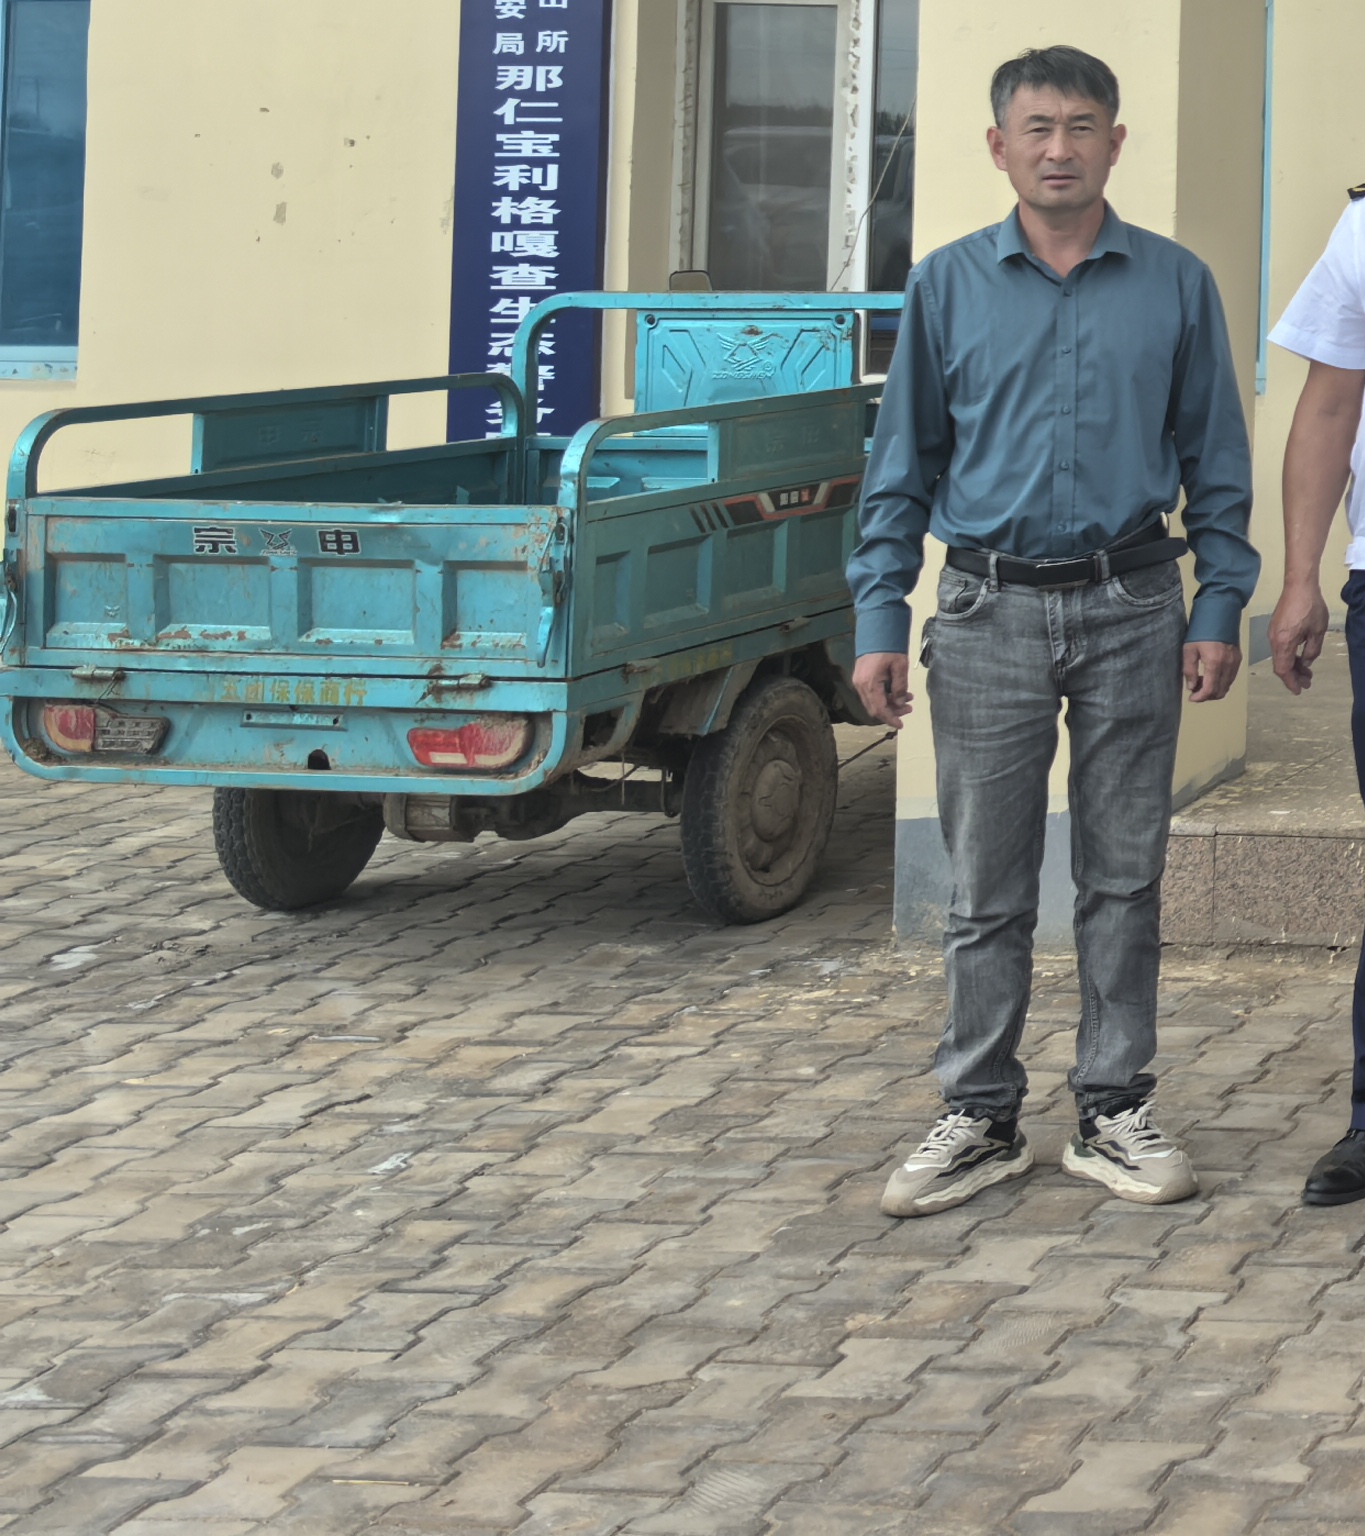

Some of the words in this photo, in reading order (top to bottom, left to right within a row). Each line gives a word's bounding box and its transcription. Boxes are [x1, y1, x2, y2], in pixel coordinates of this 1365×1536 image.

[485, 65, 563, 440] 那仁宝利格嘎查生态
